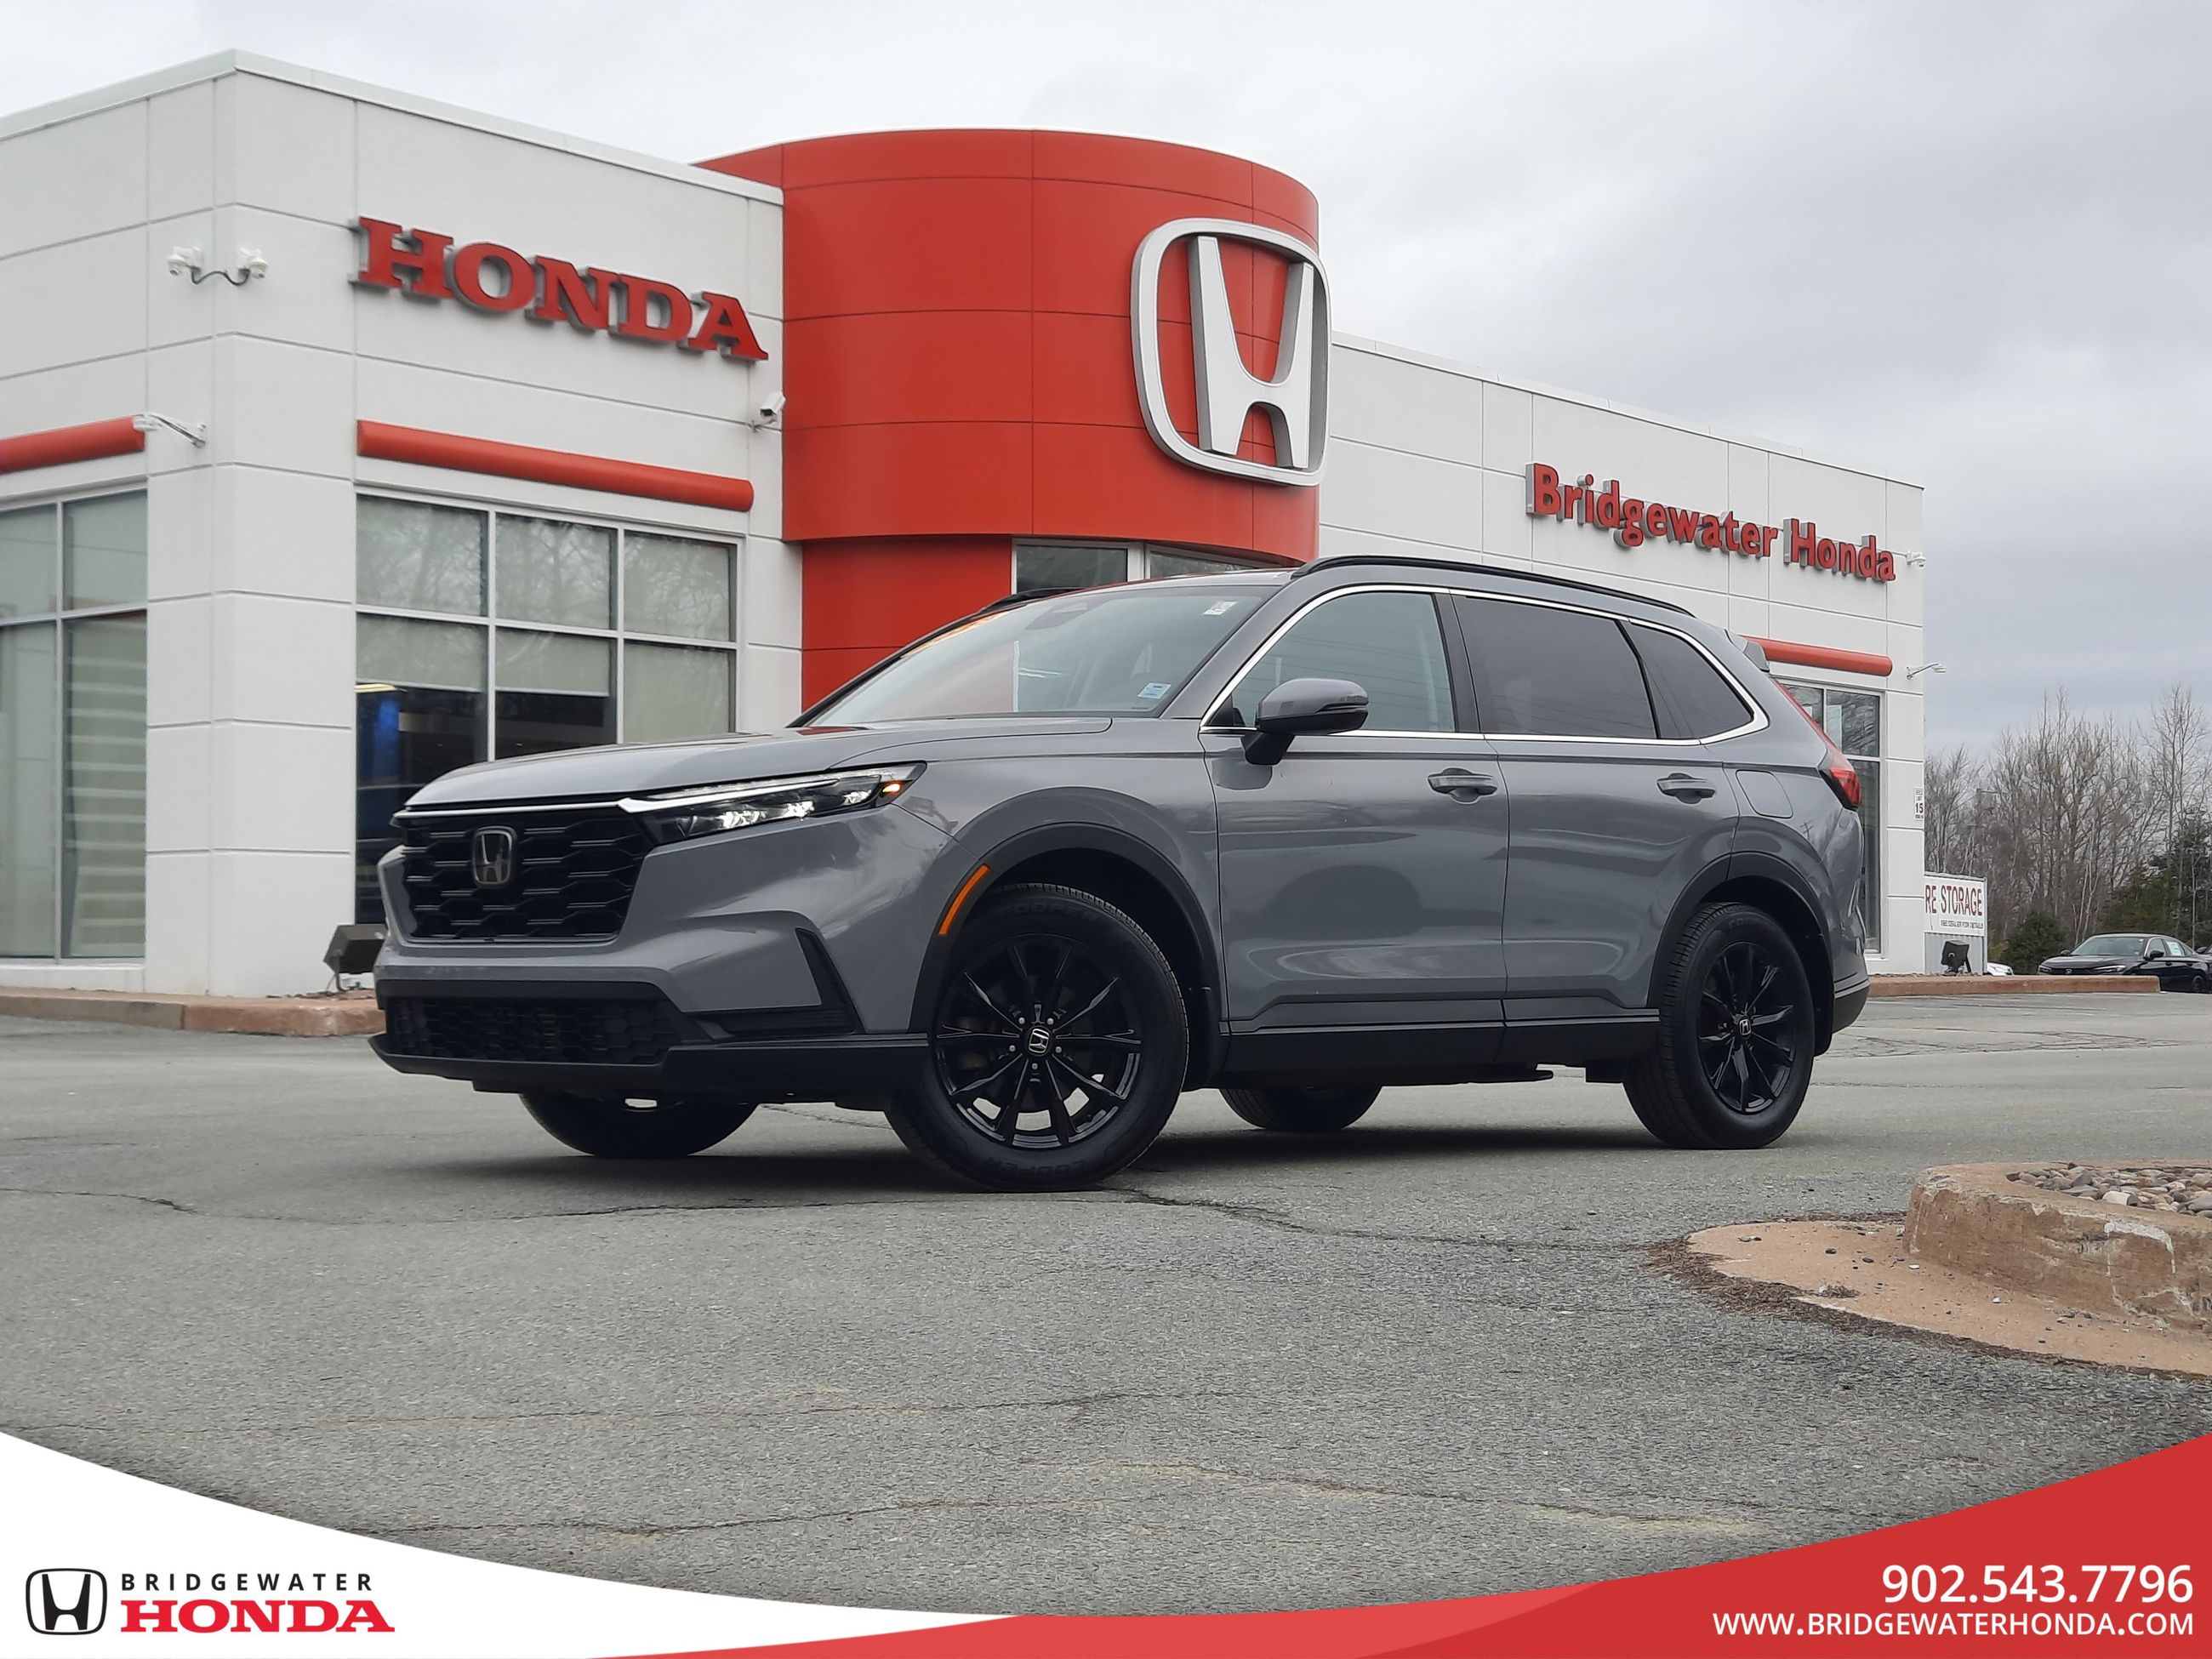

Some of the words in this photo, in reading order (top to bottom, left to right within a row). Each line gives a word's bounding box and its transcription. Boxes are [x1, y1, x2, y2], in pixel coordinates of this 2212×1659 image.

[352, 216, 769, 362] HONDA
[1528, 462, 1779, 557] Bridgewater
[1785, 518, 1896, 582] Honda
[1941, 885, 1982, 916] STORAGE
